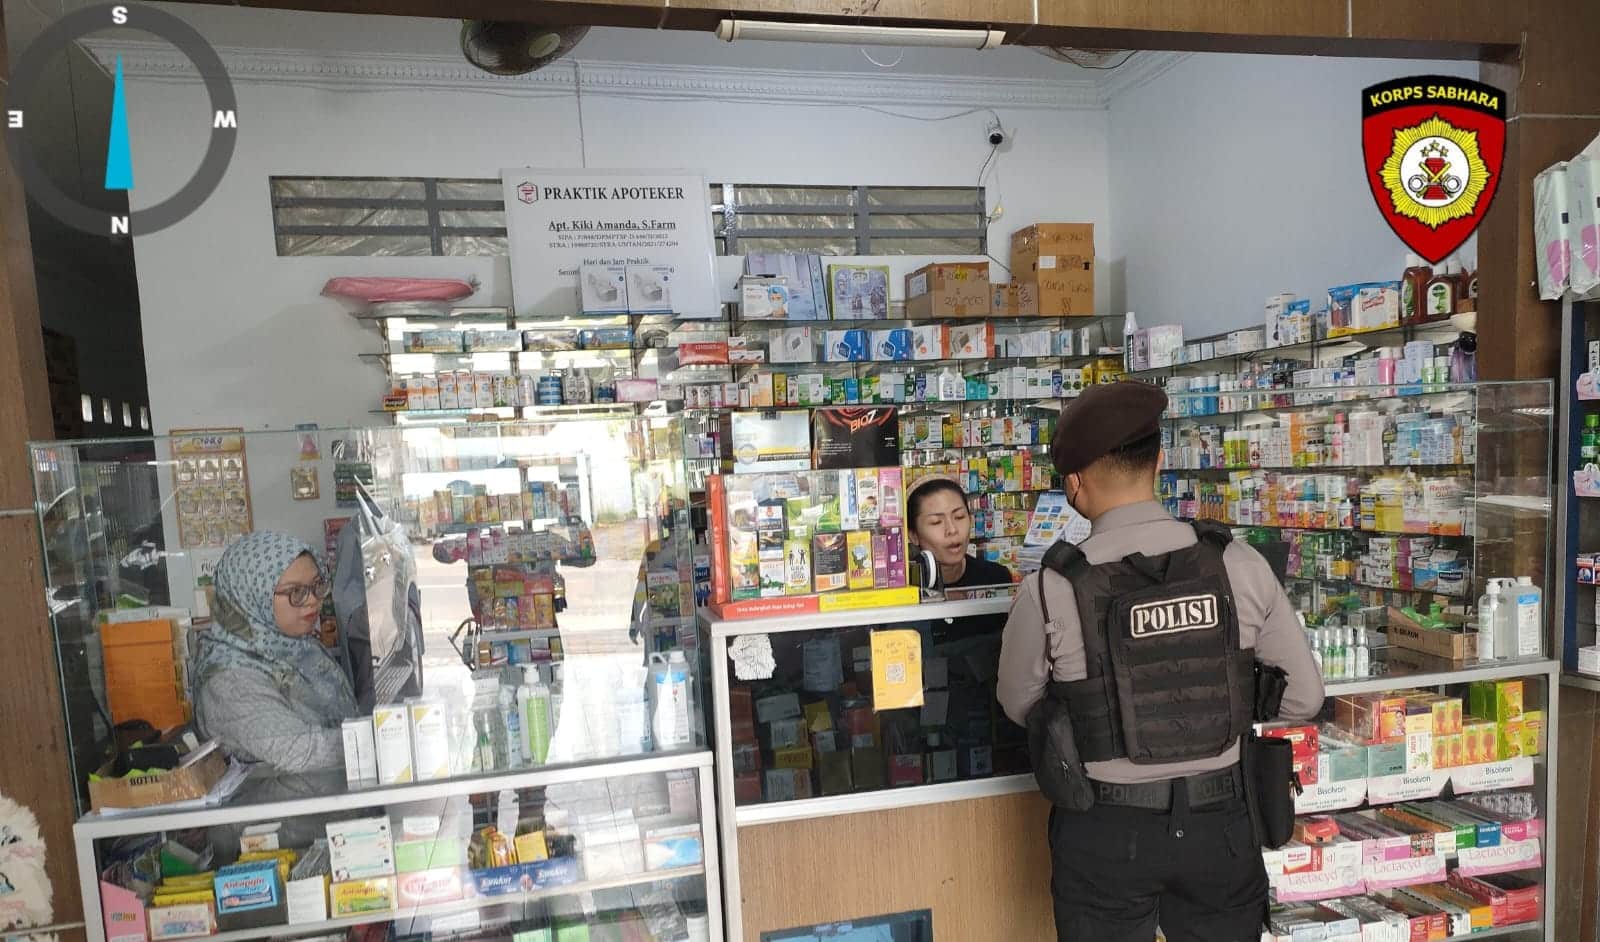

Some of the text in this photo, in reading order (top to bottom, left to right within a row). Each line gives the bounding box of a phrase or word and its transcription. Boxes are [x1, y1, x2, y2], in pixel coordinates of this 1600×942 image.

[544, 187, 684, 200] PRAKTIK APOTEKER
[548, 220, 676, 232] Apt. Kiki Amanda, S.Farm
[583, 258, 598, 266] Hari
[626, 257, 650, 265] Praktik
[850, 410, 877, 432] BIO7
[1135, 599, 1214, 634] POLISI
[1485, 766, 1513, 776] Bisolvon
[1402, 775, 1431, 785] Bisolvon
[1317, 786, 1346, 796] Bisolvon
[1468, 846, 1516, 861] Lactacyd
[1374, 859, 1421, 874] Lactacyd
[1288, 870, 1338, 886] Lactacyd
